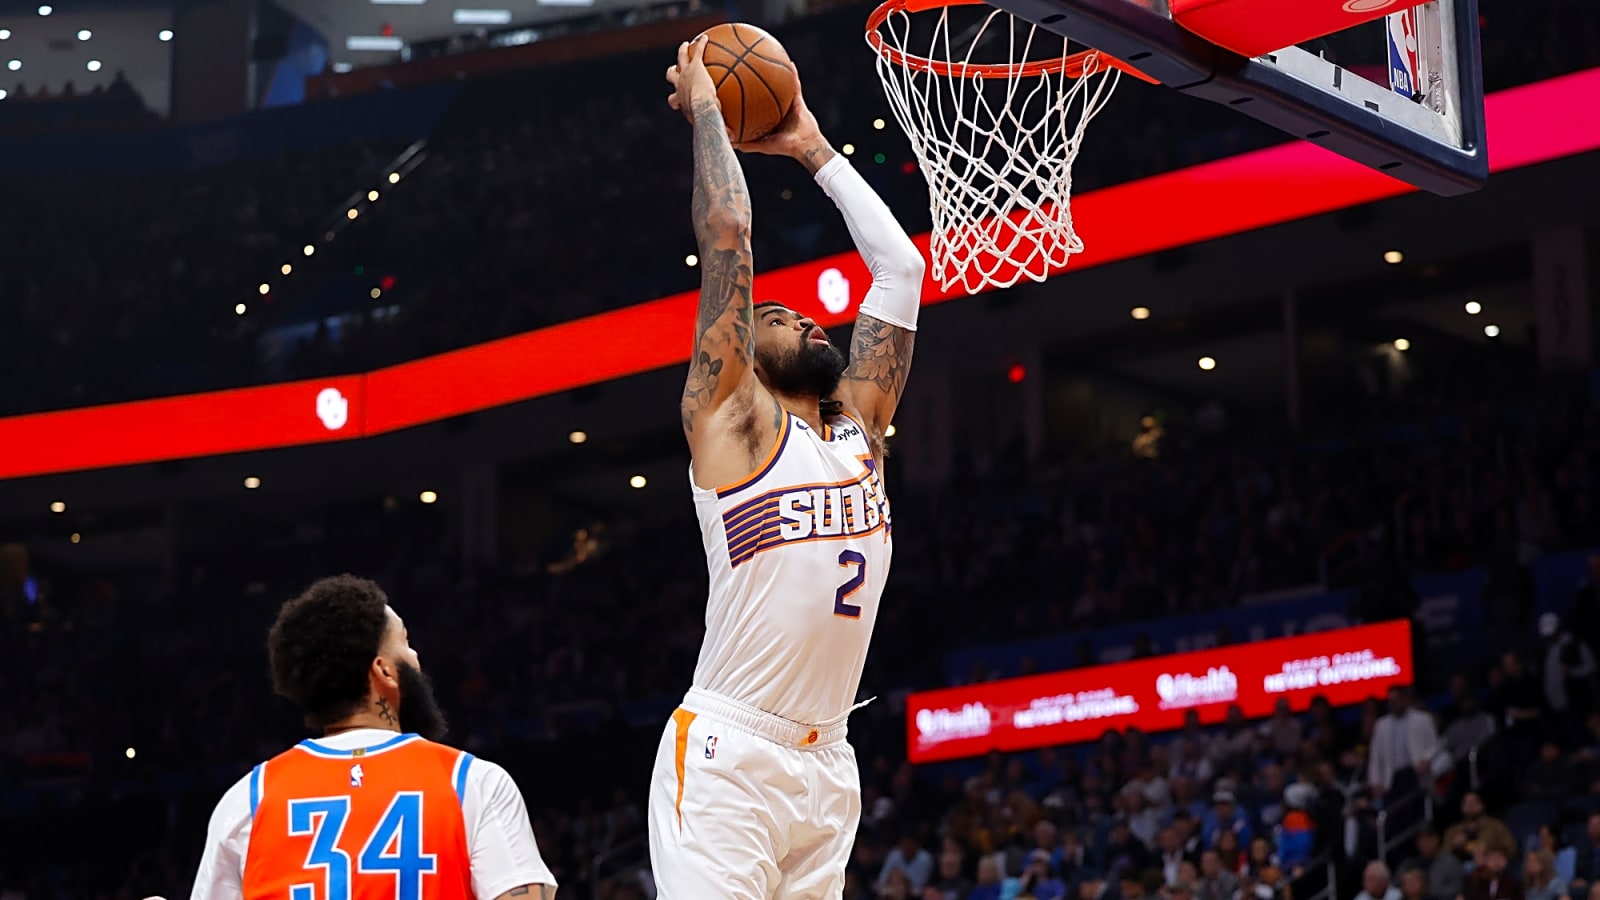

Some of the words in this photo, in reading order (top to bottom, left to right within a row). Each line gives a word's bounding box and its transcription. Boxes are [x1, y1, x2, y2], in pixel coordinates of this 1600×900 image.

[1393, 67, 1409, 92] NBA
[837, 426, 860, 441] ayPal
[779, 478, 889, 541] SUNS
[833, 549, 867, 620] 2
[287, 791, 438, 900] 34
